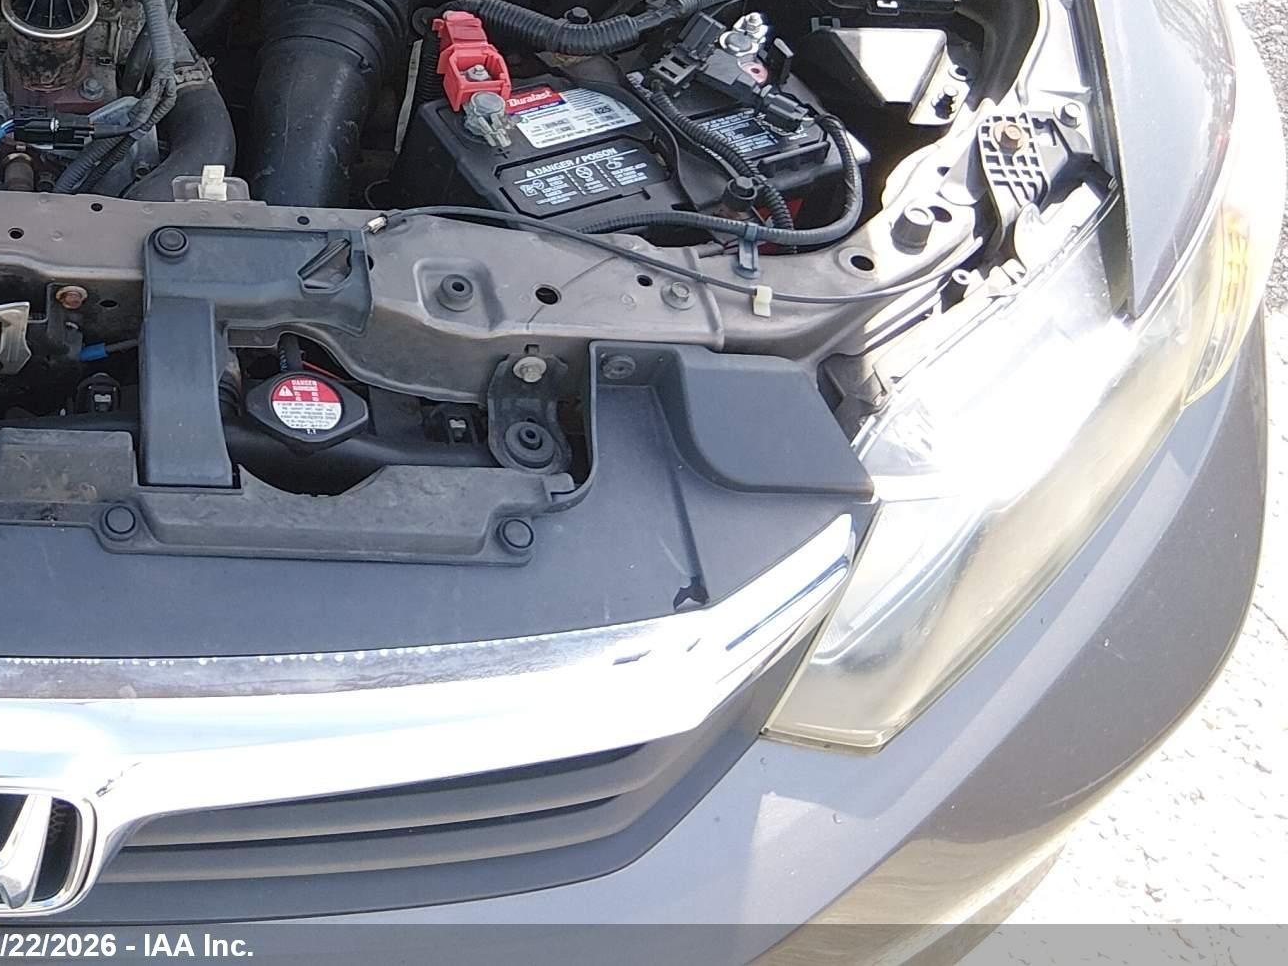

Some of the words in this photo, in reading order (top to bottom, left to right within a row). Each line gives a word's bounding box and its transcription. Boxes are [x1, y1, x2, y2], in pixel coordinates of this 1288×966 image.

[506, 90, 552, 107] Duralast
[534, 159, 575, 175] DANGER
[580, 147, 618, 162] POISON
